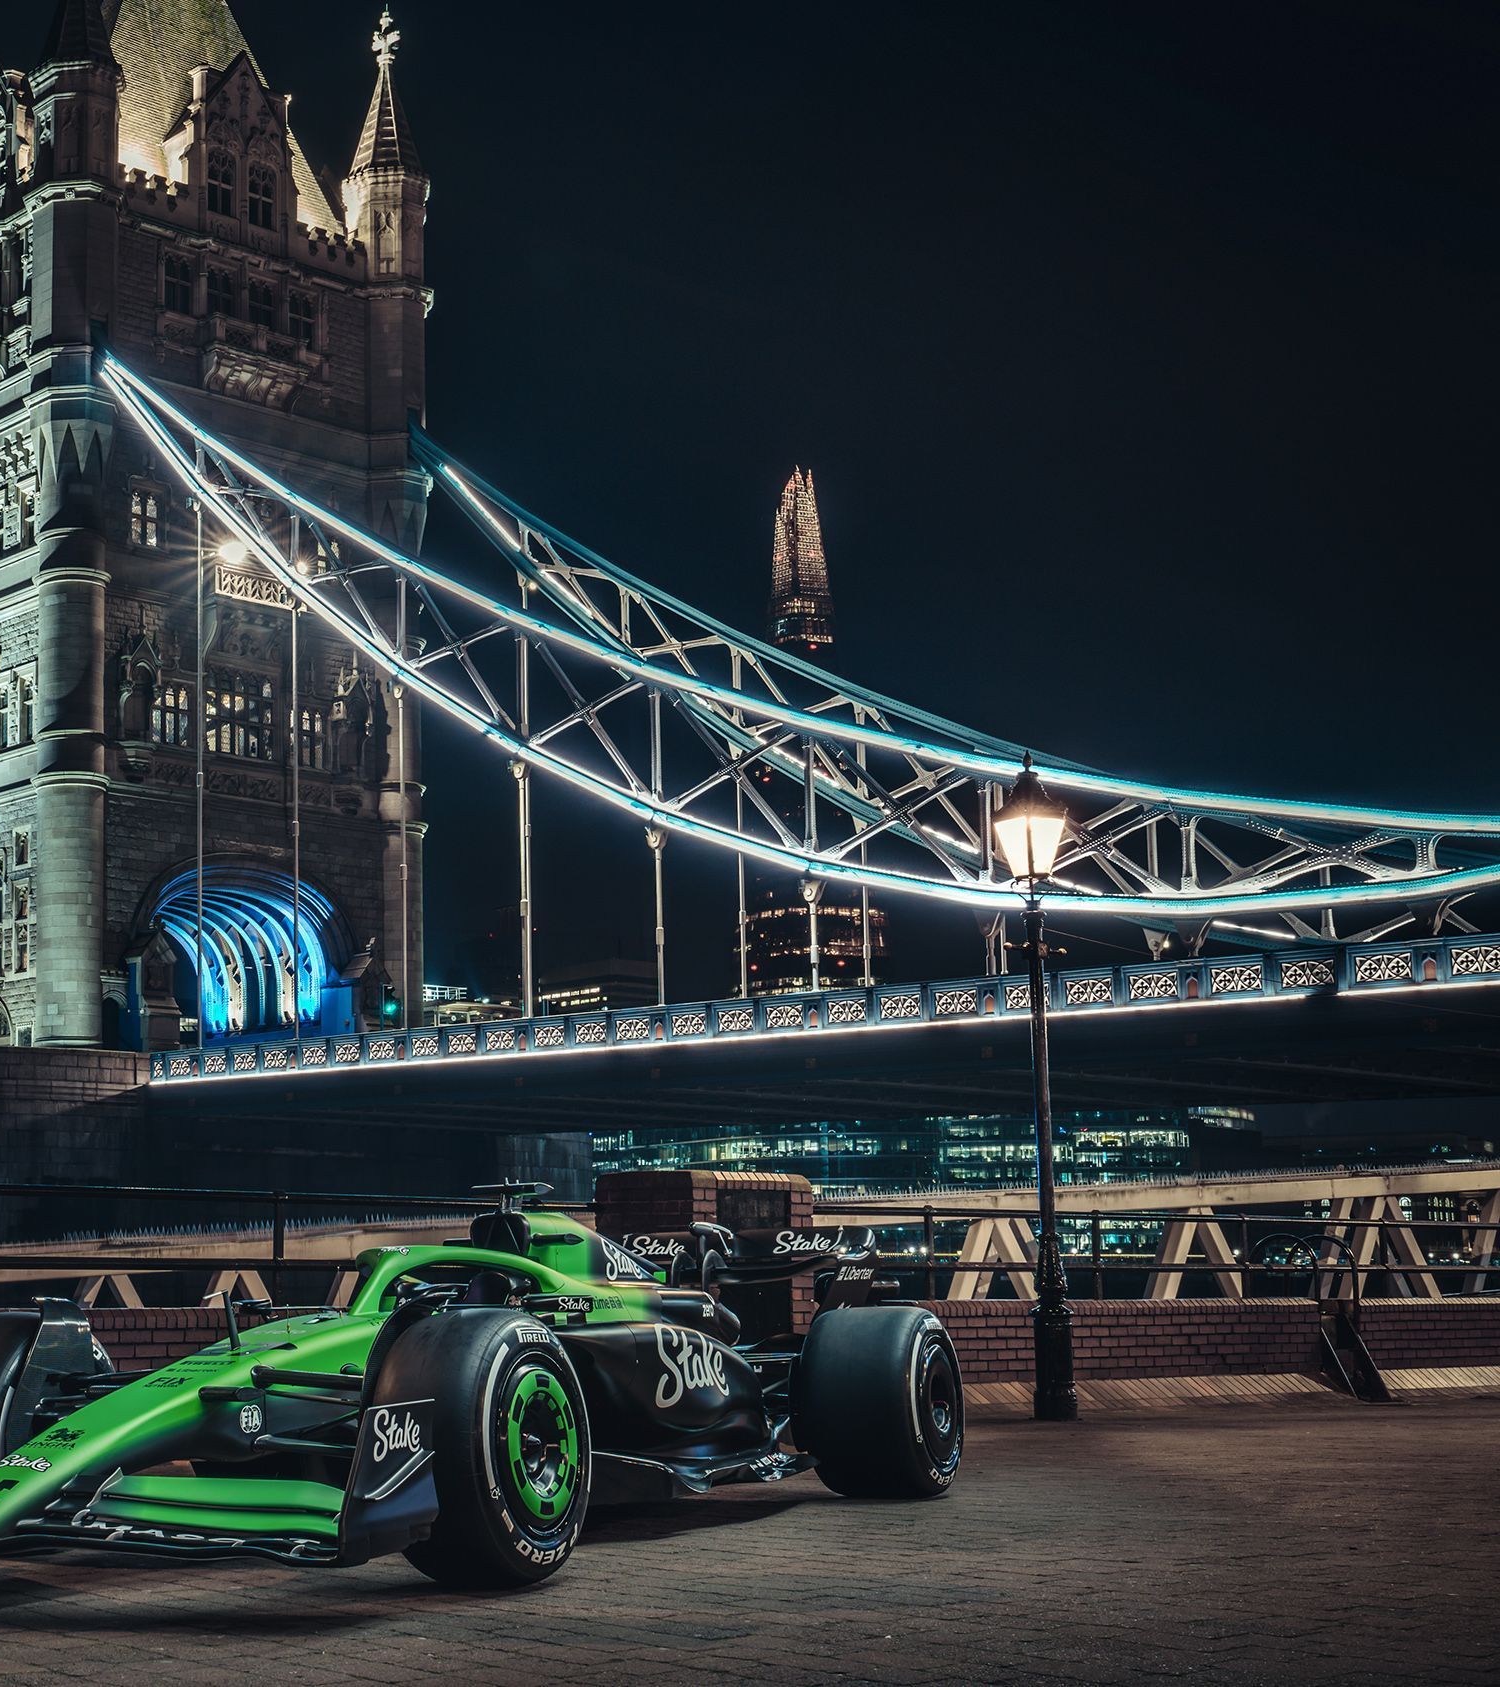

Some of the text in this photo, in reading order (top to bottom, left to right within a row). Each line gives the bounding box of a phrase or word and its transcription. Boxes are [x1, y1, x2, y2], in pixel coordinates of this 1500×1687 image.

[631, 1235, 685, 1257] Stake
[773, 1230, 831, 1254] Stake
[843, 1265, 875, 1281] Libertex
[558, 1296, 591, 1312] Stake
[515, 1327, 550, 1343] PIRELLI
[655, 1323, 730, 1409] Stake
[241, 1408, 262, 1430] FIA
[373, 1408, 420, 1462] Stake
[515, 1540, 567, 1565] ZERO
